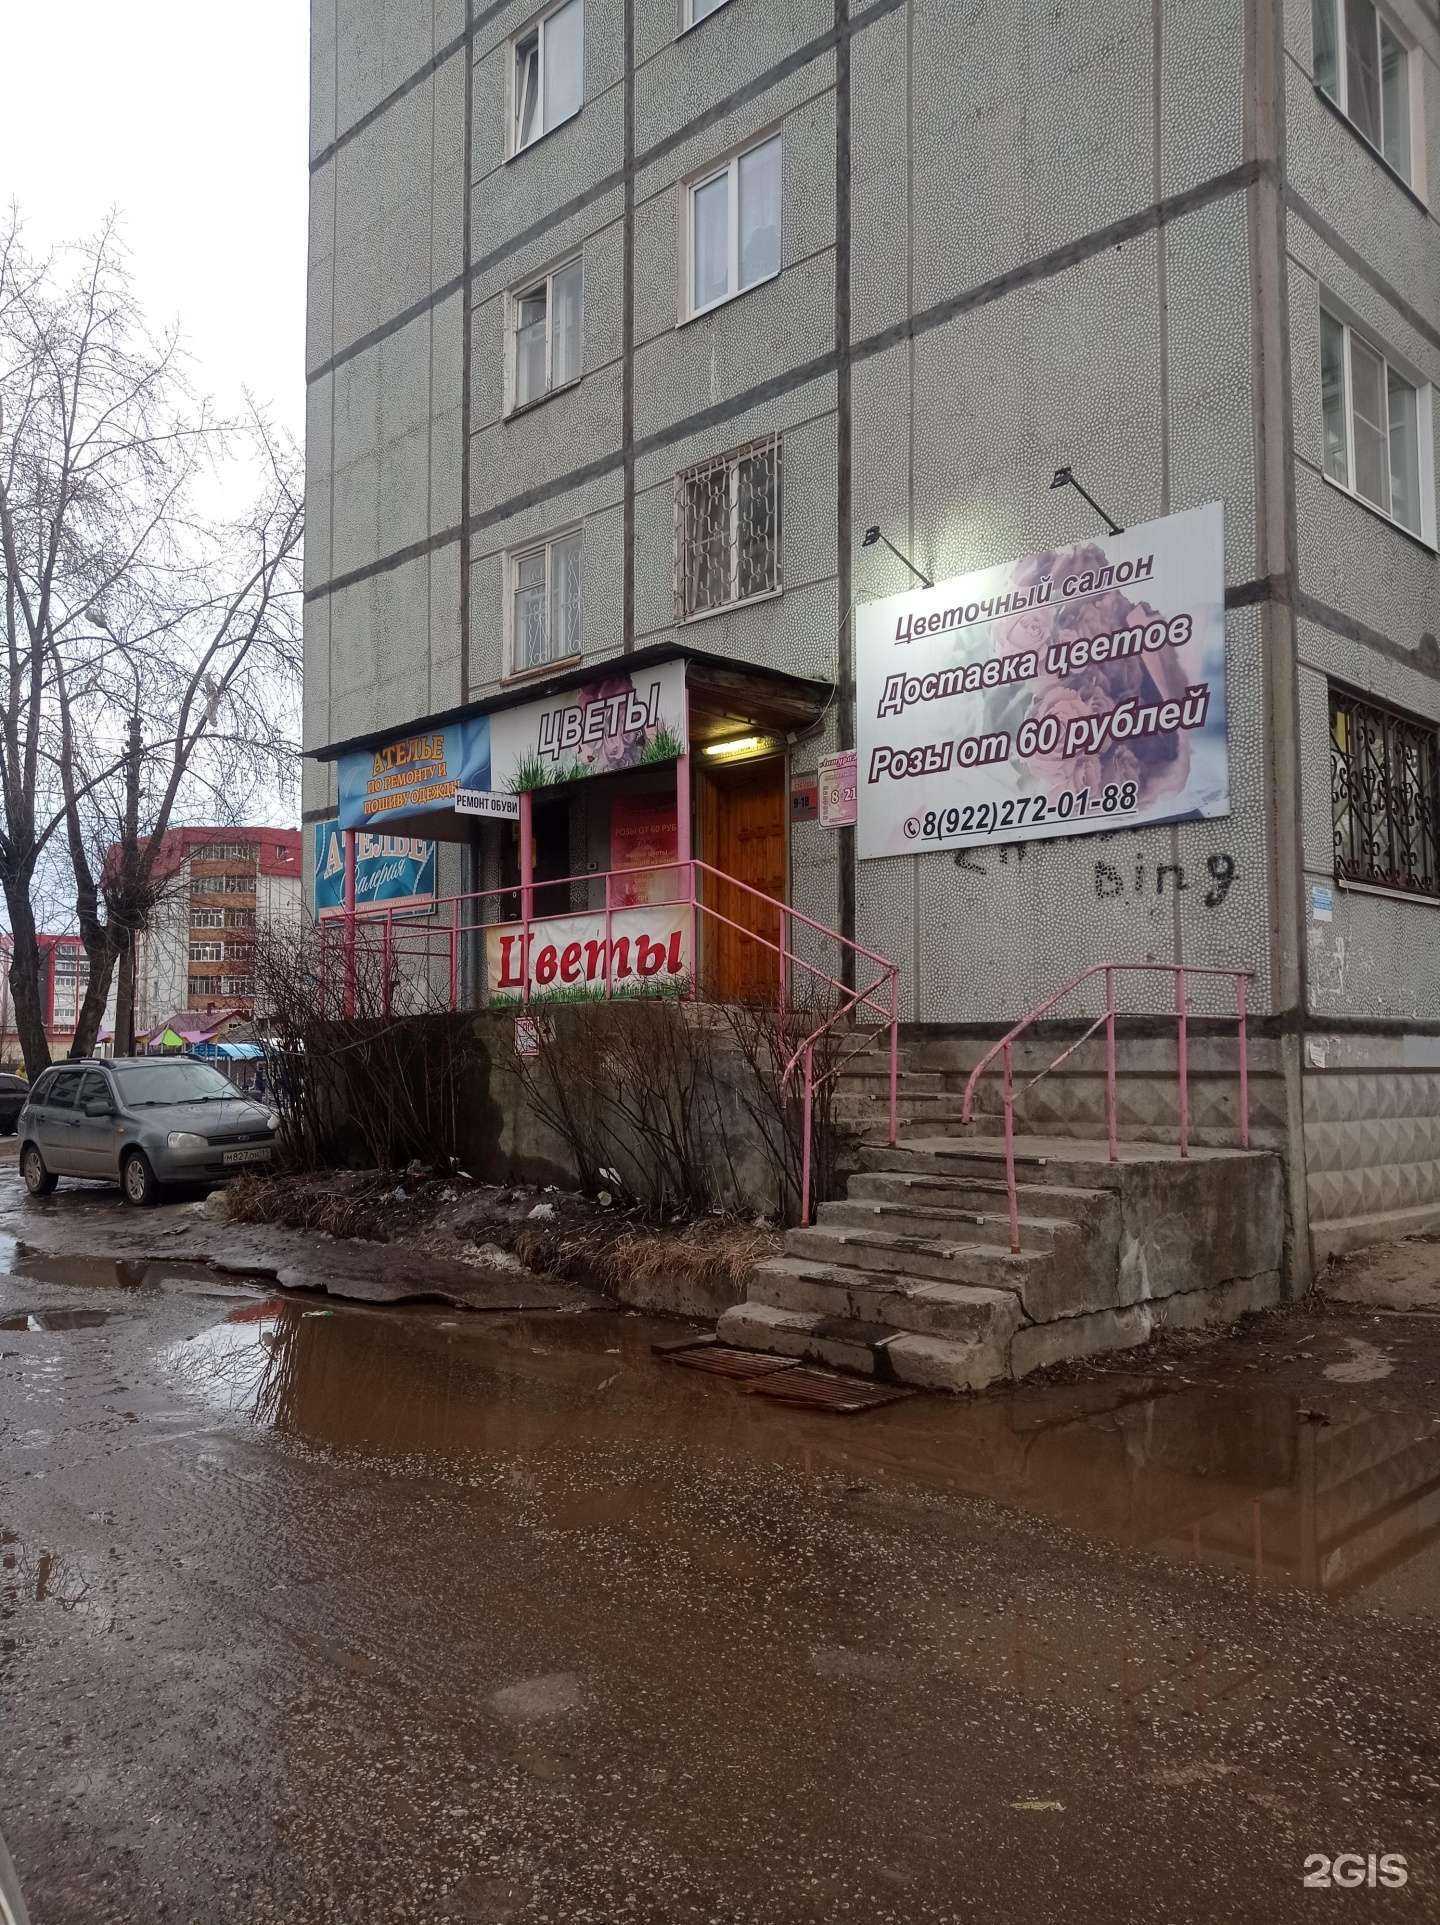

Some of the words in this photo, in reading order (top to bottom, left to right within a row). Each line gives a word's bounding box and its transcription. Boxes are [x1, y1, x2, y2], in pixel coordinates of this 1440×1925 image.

[895, 576, 1054, 643] Цветочный
[1062, 555, 1154, 595] салон
[877, 650, 1038, 718] Доставка
[1045, 612, 1193, 678] цветов
[537, 682, 662, 762] ЦВЕТЫ
[868, 741, 952, 783] Розы
[955, 732, 1009, 766] от
[1015, 717, 1058, 756] 60
[1062, 683, 1211, 760] рублей
[367, 778, 383, 795] ПО
[383, 766, 437, 791] РЕМОНТУ
[437, 762, 448, 777] И
[372, 735, 445, 776] АТЕЛЬЕ
[364, 791, 411, 815] ПОШИВУ
[456, 794, 490, 810] РЕМОНТ
[491, 799, 518, 814] ОБУВИ
[831, 790, 839, 804] 8
[921, 782, 1138, 841] 8(922)272-01-88
[497, 930, 684, 989] Цветы
